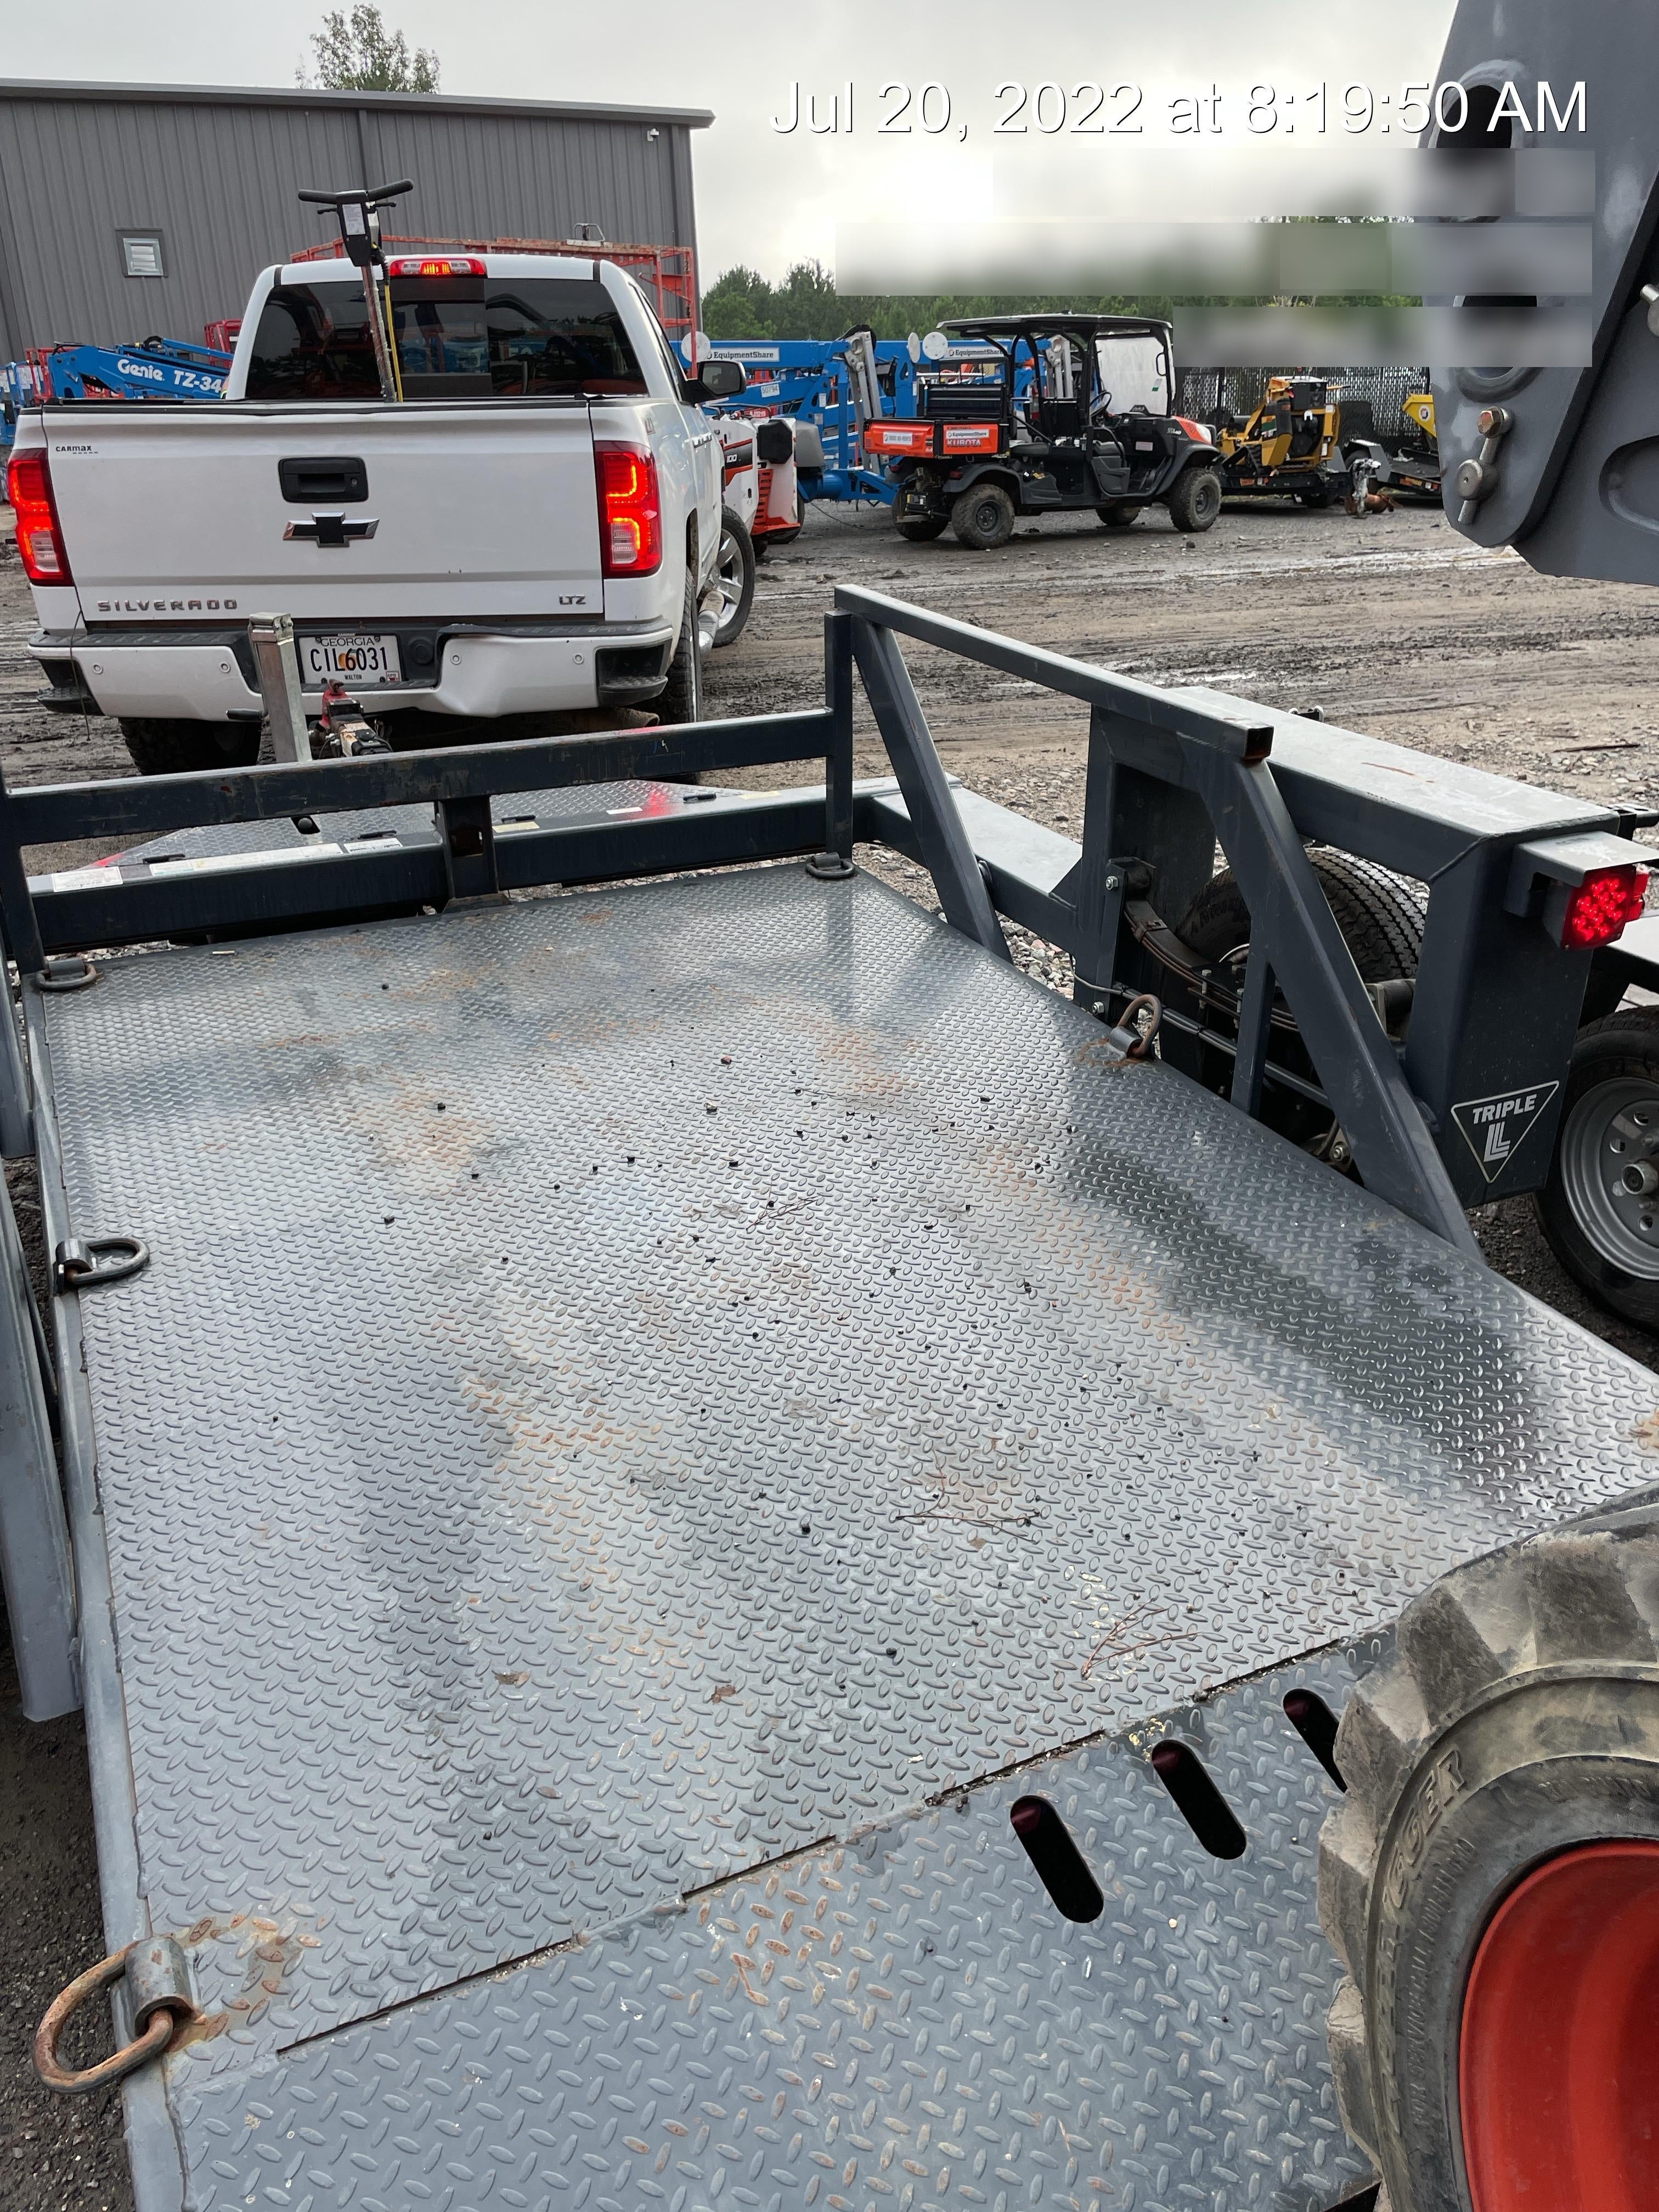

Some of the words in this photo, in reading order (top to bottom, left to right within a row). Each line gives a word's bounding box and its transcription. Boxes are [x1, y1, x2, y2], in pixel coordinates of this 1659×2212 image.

[714, 351, 774, 359] EquipmentShare
[117, 359, 163, 381] Genie
[559, 595, 586, 605] LTZ
[98, 600, 237, 612] SILVERADO
[321, 637, 375, 646] GEORGIA
[1472, 1094, 1537, 1124] TRIPLE
